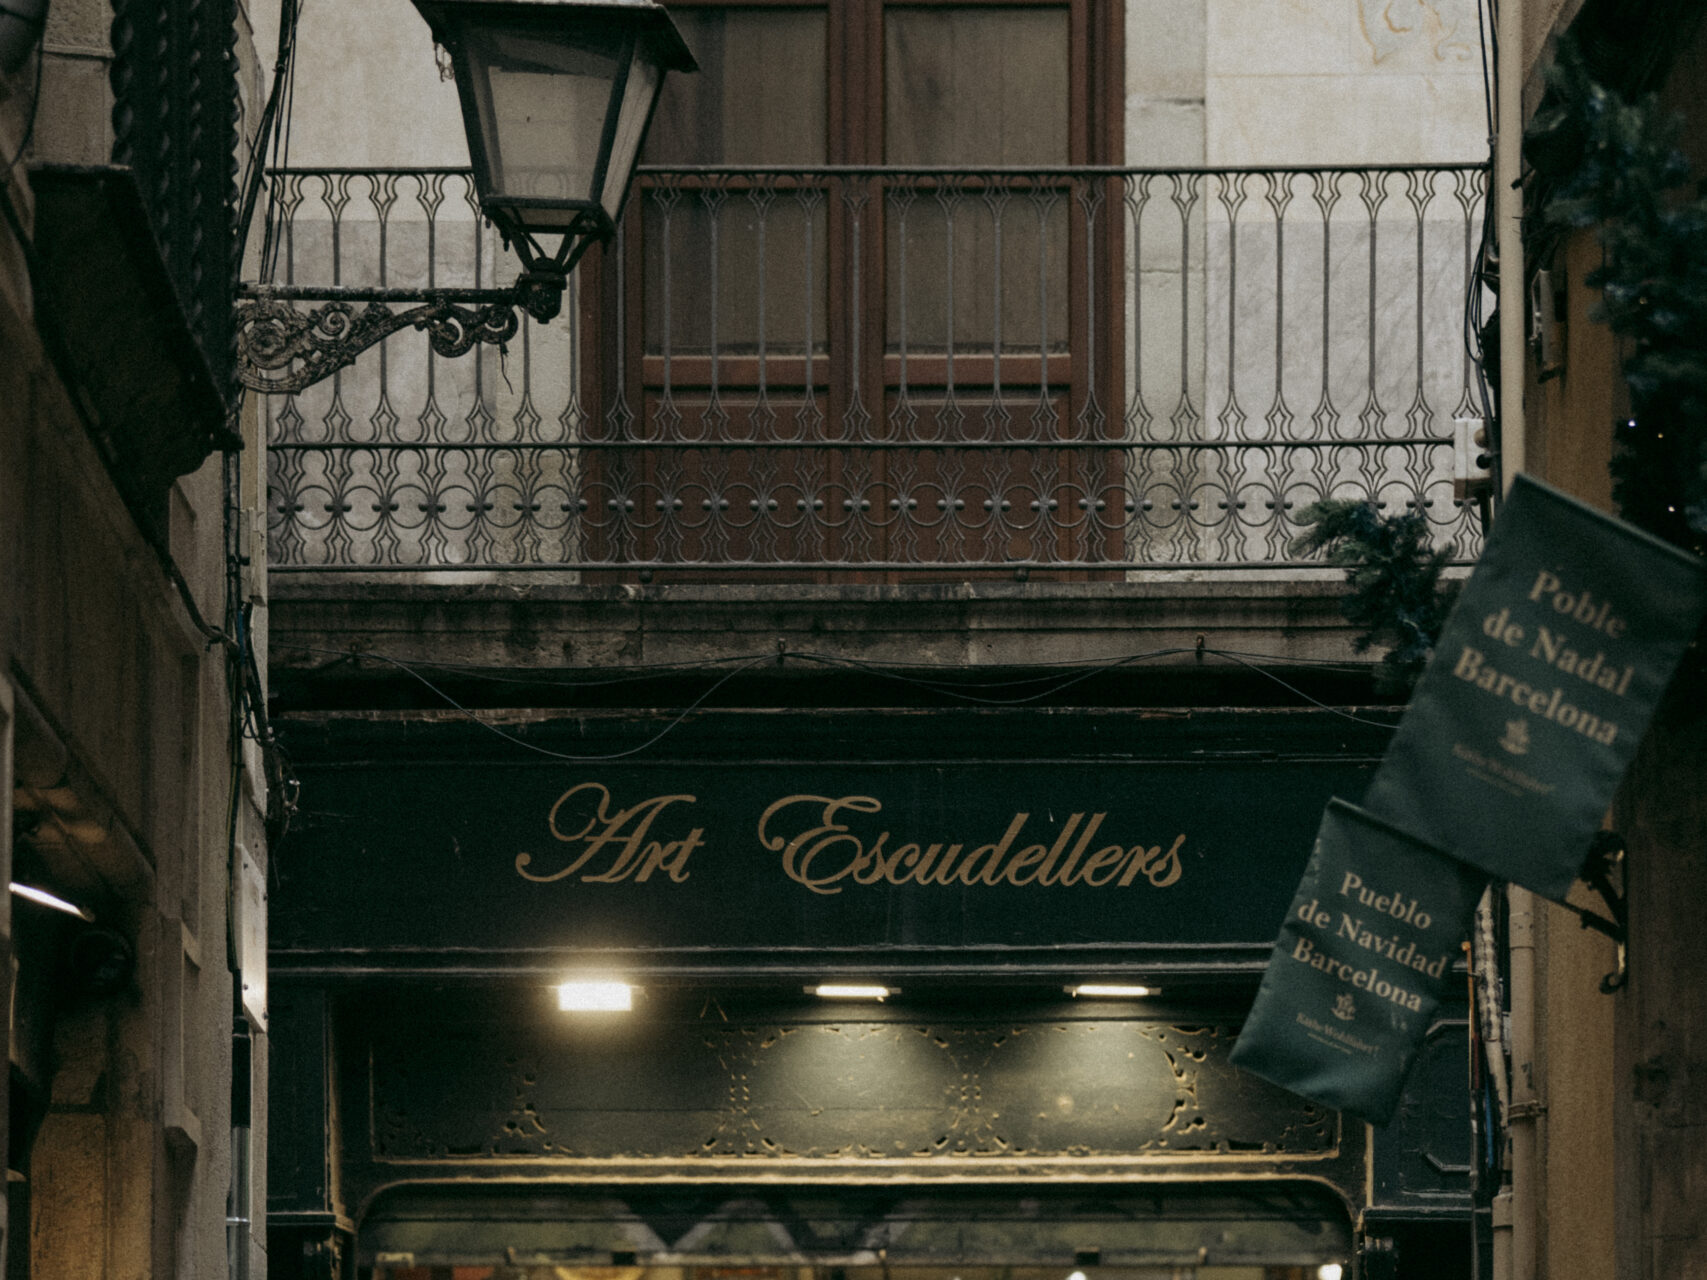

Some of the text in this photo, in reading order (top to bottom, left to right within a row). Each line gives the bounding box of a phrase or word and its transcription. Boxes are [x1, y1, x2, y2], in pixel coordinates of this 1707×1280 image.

[1529, 570, 1626, 638] Poble
[1482, 607, 1635, 697] de Nadal
[1452, 645, 1619, 747] Barcelona
[515, 782, 1185, 895] Art Escudellers
[1297, 898, 1448, 980] de Navidad
[1338, 871, 1432, 930] Pueblo
[1291, 936, 1422, 1013] Barcelona
